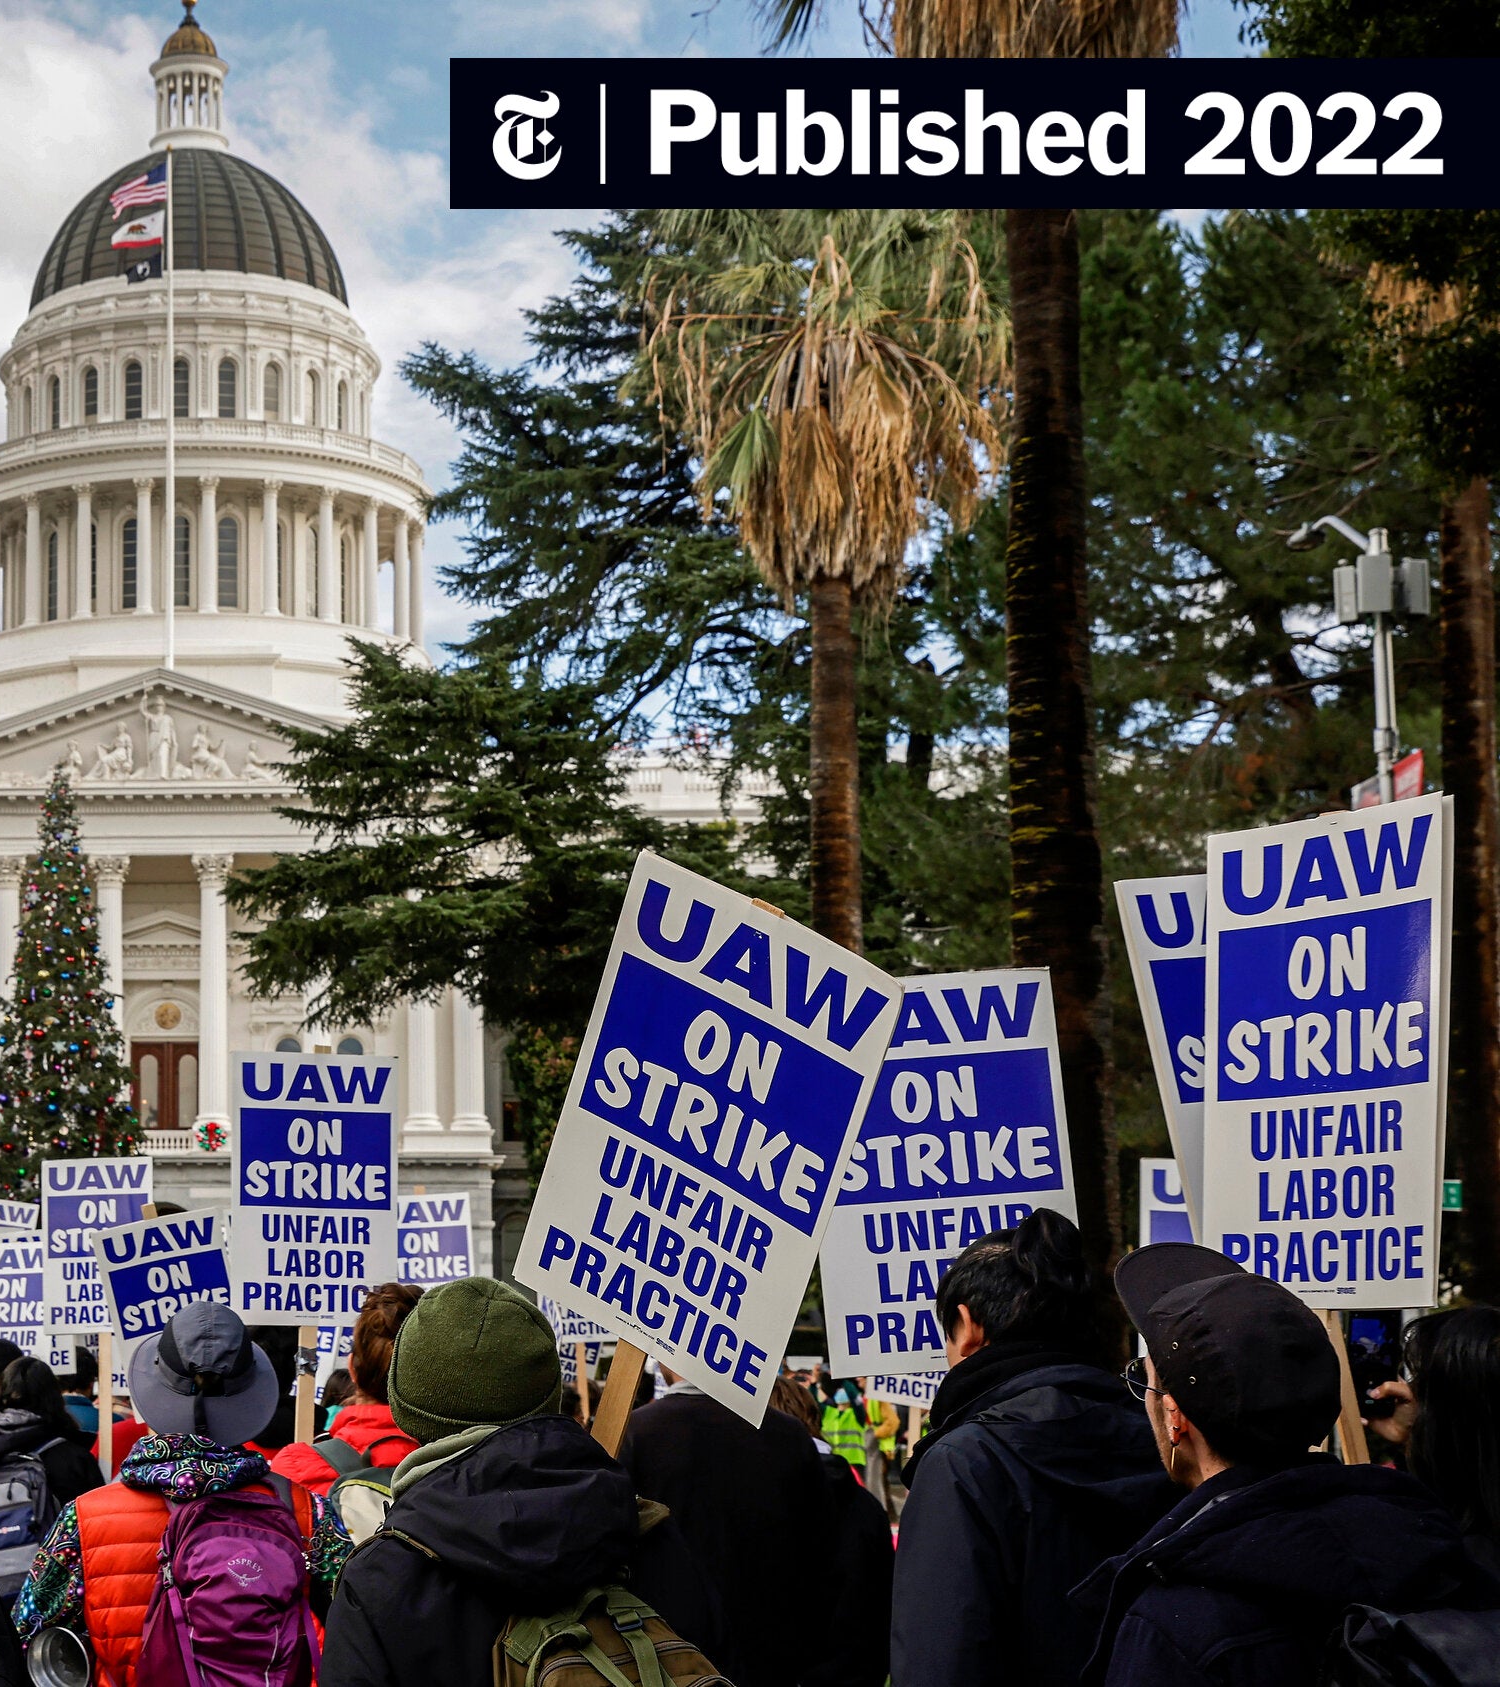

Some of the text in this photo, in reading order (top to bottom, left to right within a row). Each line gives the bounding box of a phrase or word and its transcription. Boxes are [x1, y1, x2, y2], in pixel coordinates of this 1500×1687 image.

[1223, 814, 1432, 916] UAW
[637, 879, 889, 1053] UAW
[1288, 926, 1367, 999] ON
[889, 982, 1040, 1048] AW
[684, 1009, 782, 1105] ON
[1224, 1001, 1424, 1085] STRIKE
[242, 1062, 392, 1104] UAW
[890, 1065, 978, 1124] ON
[287, 1118, 342, 1156] ON
[594, 1047, 825, 1215] STRIKE
[1250, 1100, 1403, 1162] UNFAIR
[49, 1164, 147, 1191] UAW
[244, 1160, 386, 1201] STRIKE
[1258, 1164, 1395, 1222] LABOR
[78, 1199, 117, 1223] ON
[398, 1199, 465, 1223] AW
[600, 1135, 773, 1275] UNFAIR
[50, 1227, 100, 1253] STR
[102, 1216, 214, 1264] UAW
[262, 1214, 370, 1245] UNFAIR
[403, 1231, 439, 1254] ON
[62, 1261, 99, 1281] UNF
[267, 1248, 364, 1279] LABOR
[398, 1255, 468, 1279] TRIKE
[590, 1196, 748, 1322] LABOR
[1222, 1225, 1424, 1283] PRACTICE
[66, 1284, 104, 1302] LAB
[147, 1261, 192, 1293] ON
[51, 1305, 112, 1325] PRACT
[242, 1282, 378, 1314] PRACTIC
[538, 1226, 767, 1397] PRACTICE
[562, 1321, 610, 1335] ACTI
[874, 1375, 939, 1399] PRACTI
[227, 1558, 263, 1572] OSPREY
